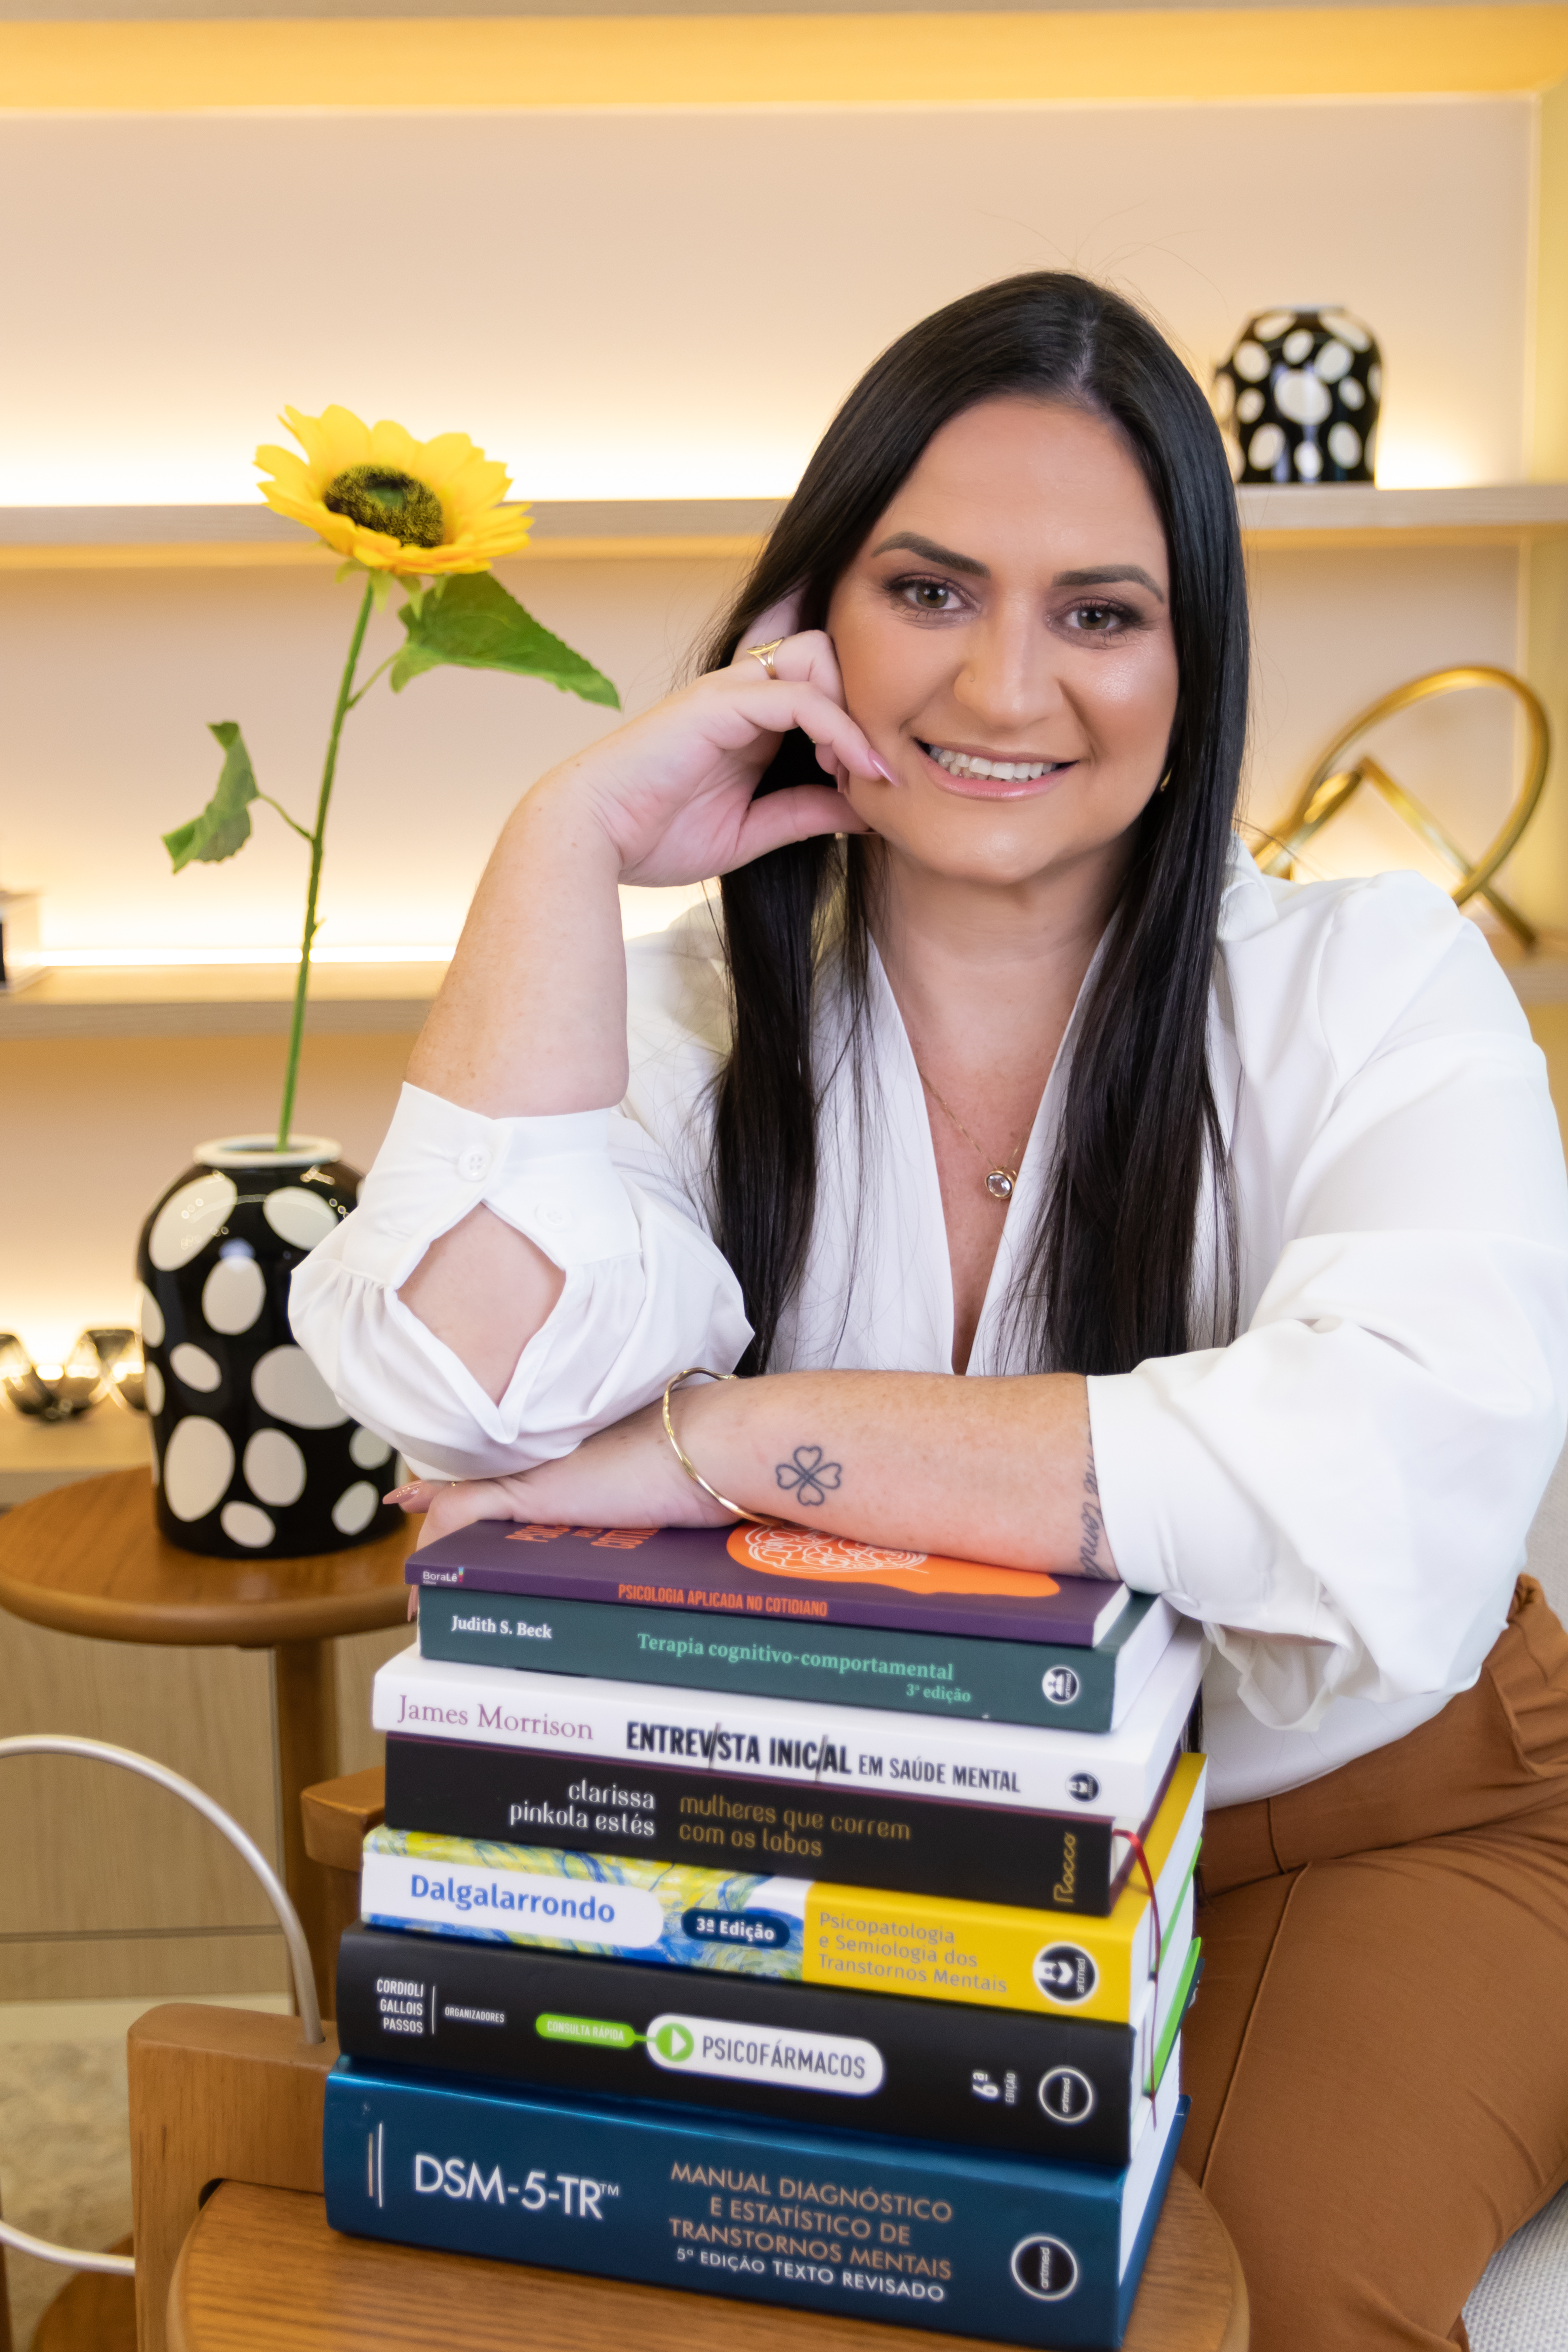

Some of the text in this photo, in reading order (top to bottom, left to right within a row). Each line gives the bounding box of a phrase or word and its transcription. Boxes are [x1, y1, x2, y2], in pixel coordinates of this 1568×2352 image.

[618, 1584, 828, 1617] PSICOLOGIA APLICADA NO COTIDIANO
[451, 1615, 552, 1639] Judith S. Beck
[637, 1633, 954, 1680] Terapia cognitivo-comportamental
[923, 1687, 971, 1704] edição
[398, 1695, 594, 1740] James Morrison
[858, 1754, 883, 1777] EM
[889, 1756, 946, 1784] SAÚDE
[952, 1765, 1021, 1793] MENTAL
[568, 1778, 655, 1809] clarissa
[509, 1801, 655, 1836] pinkola estés
[680, 1794, 911, 1840] mulheres que correm
[679, 1823, 822, 1857] com os lobos
[1053, 1831, 1077, 1903] Rocco
[411, 1874, 615, 1923] Dalgalarrondo
[720, 1920, 774, 1941] Edição
[820, 1912, 954, 1945] Psicopatologia
[819, 1935, 978, 1967] e Semiologia dos
[376, 1979, 424, 1997] CORDIOLI
[819, 1954, 1007, 1993] Transtornos Mentais
[1076, 1958, 1085, 1993] artmed
[380, 1999, 423, 2016] GALLOIS
[445, 2007, 504, 2022] ORGANIZADORES
[383, 2018, 423, 2033] PASSOS
[546, 2020, 624, 2042] CONSULTA RÁPIDA
[703, 2035, 865, 2079] PSICOFÁRMACOS
[1005, 2073, 1017, 2103] EDIÇÃO
[671, 2162, 952, 2222] MANUAL DIAGNÓSTICO
[710, 2197, 910, 2245] E ESTATÍSTICO DE
[669, 2218, 952, 2281] TRANSTORNOS MENTAIS
[700, 2251, 765, 2273] EDIÇÃO
[773, 2260, 833, 2284] TEXTO
[843, 2272, 945, 2302] REVISADO
[1040, 2247, 1050, 2289] artmed
